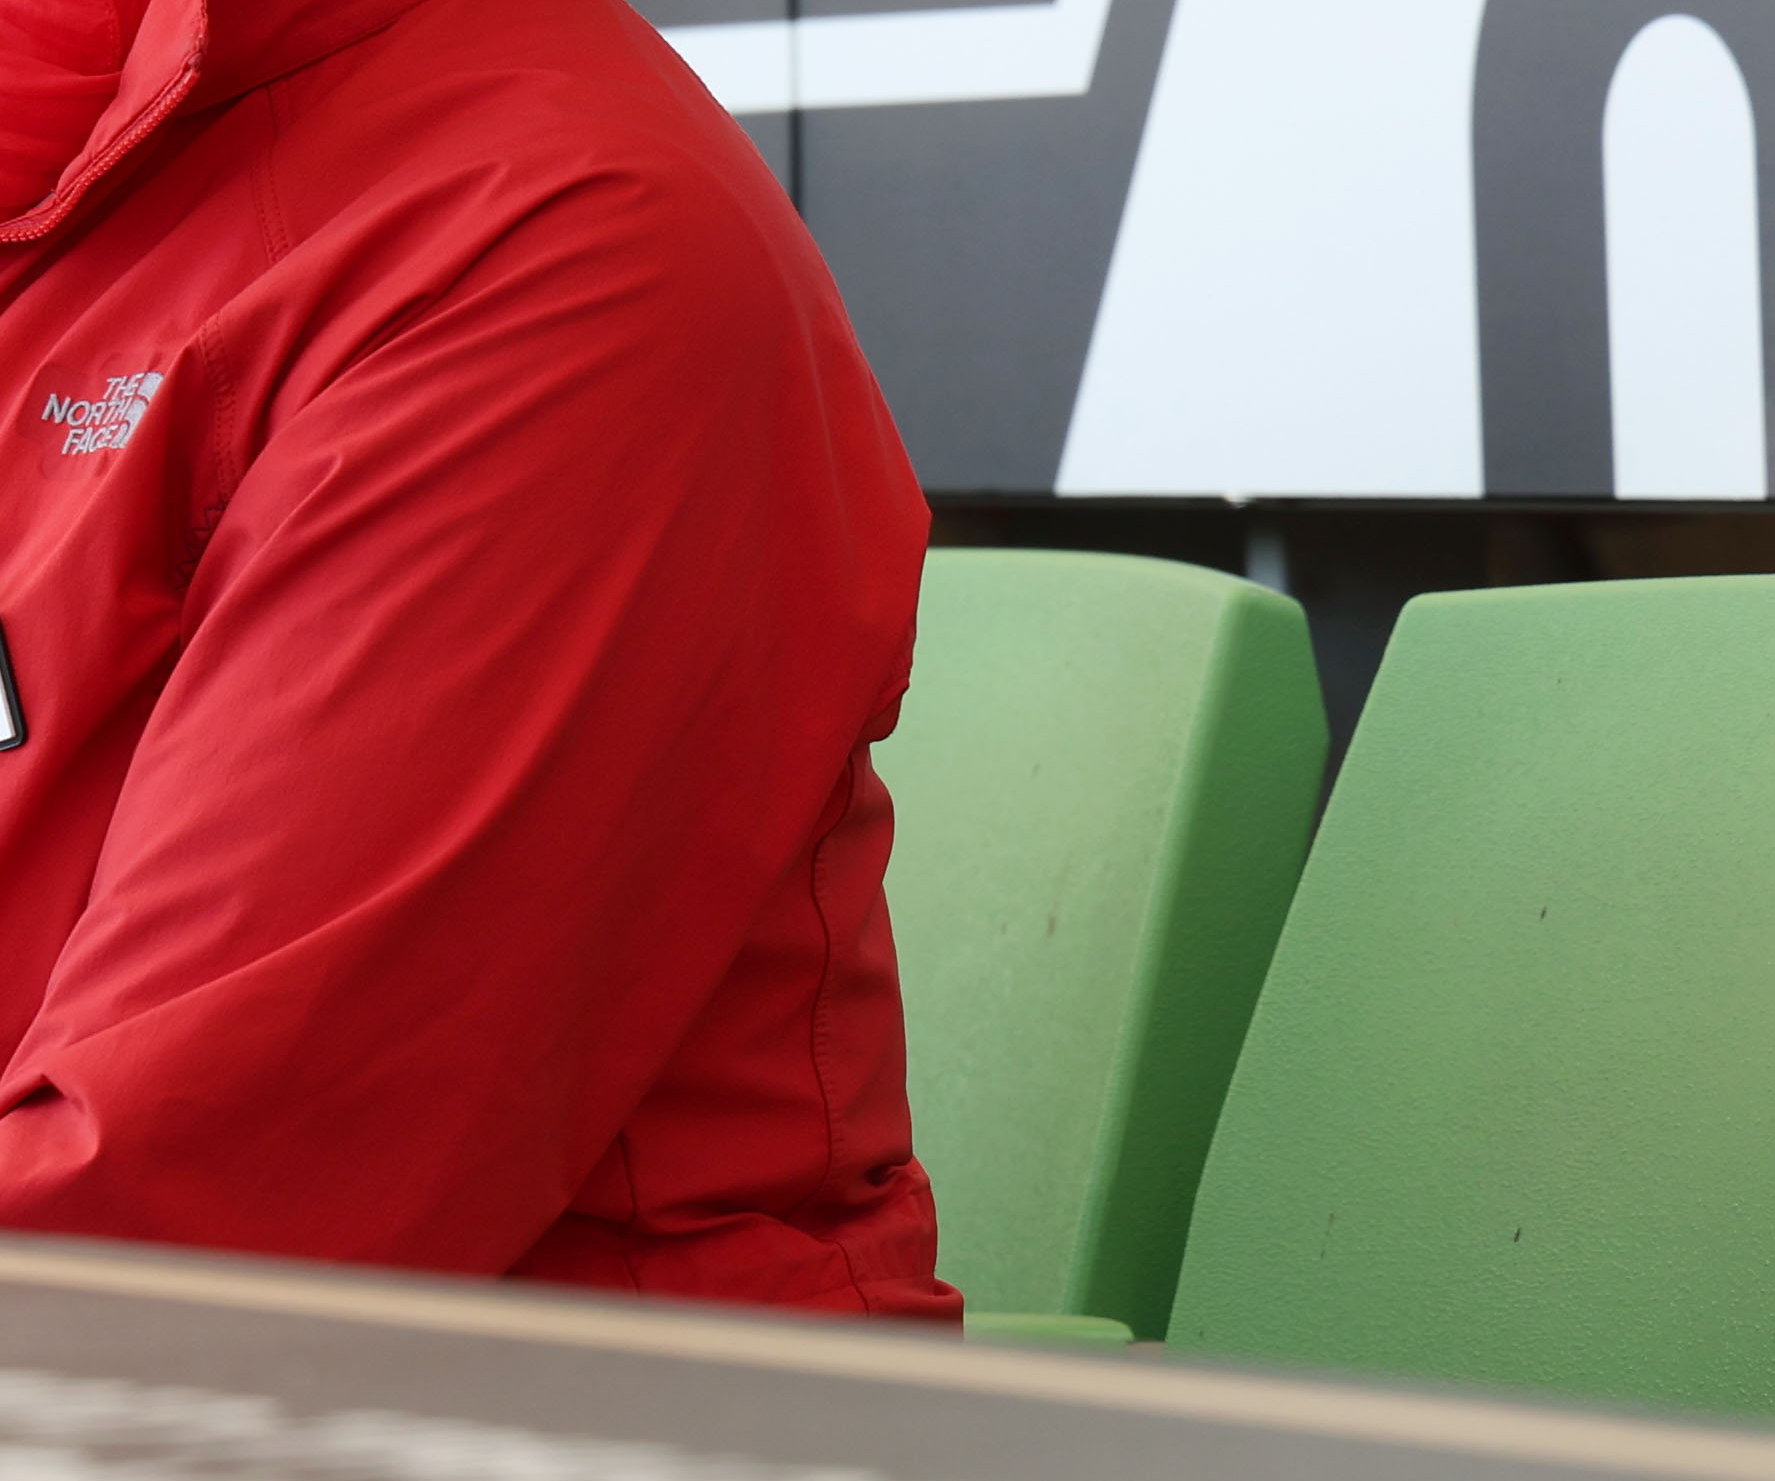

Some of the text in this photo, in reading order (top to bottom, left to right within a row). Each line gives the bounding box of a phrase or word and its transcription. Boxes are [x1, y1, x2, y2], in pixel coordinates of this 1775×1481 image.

[103, 372, 145, 400] THE
[41, 392, 134, 427] NORTH
[61, 423, 119, 455] FACE
